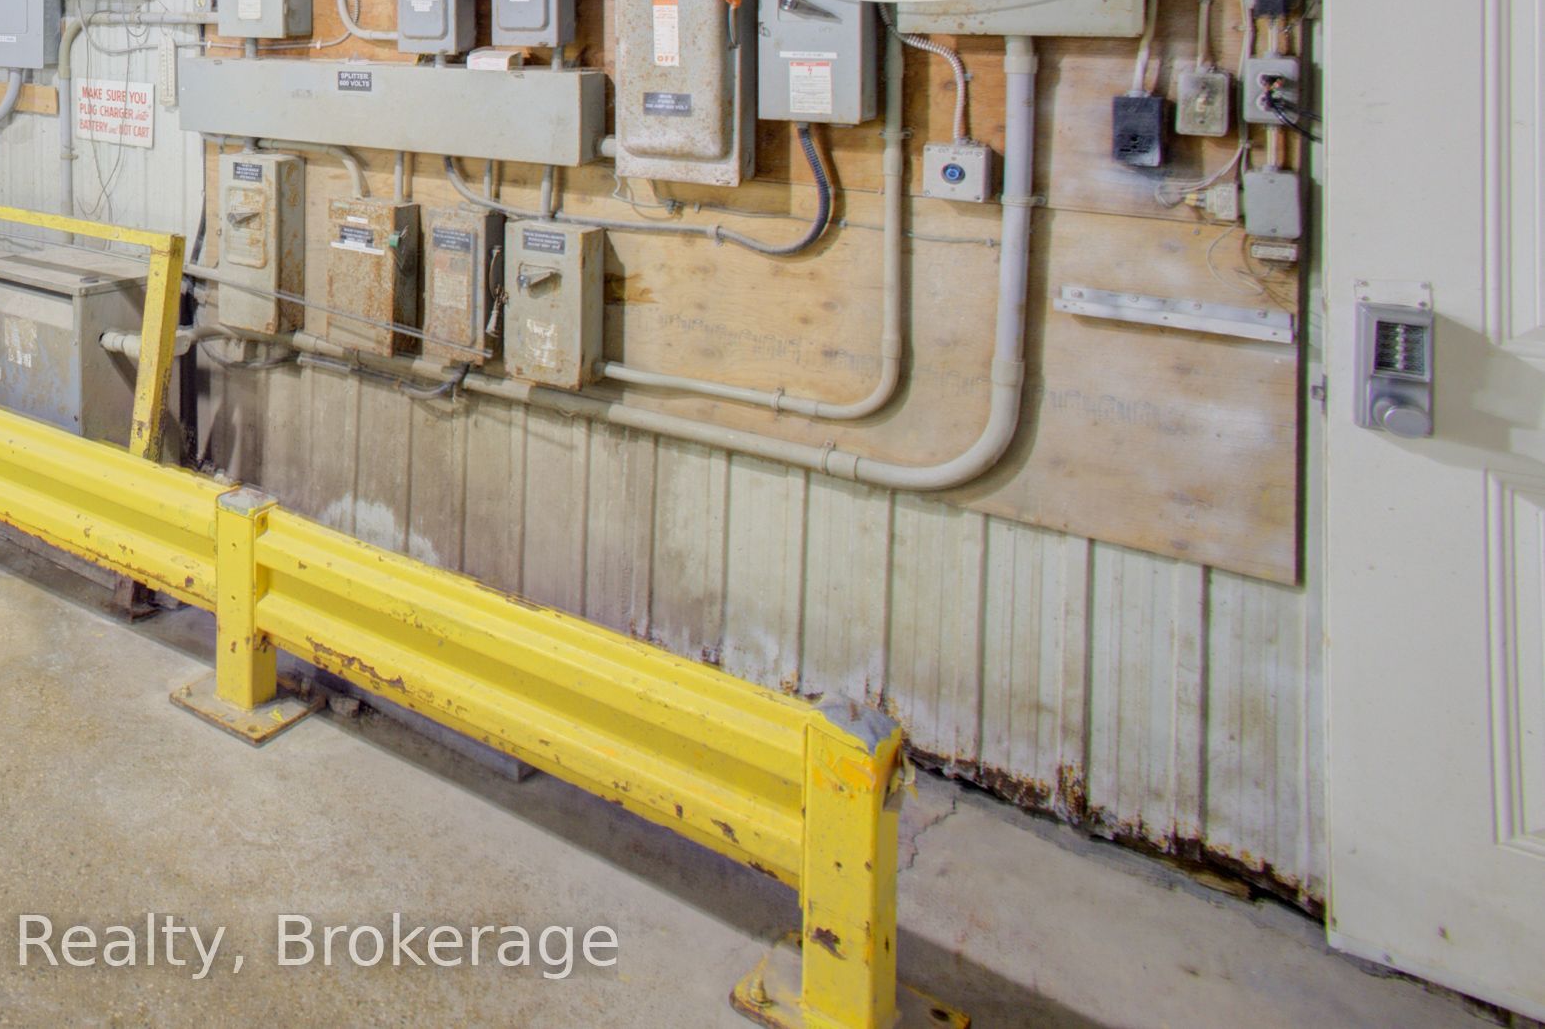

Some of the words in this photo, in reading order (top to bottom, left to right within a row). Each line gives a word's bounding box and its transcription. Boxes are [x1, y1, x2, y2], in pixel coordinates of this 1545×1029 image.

[82, 86, 103, 100] MAKE
[106, 89, 126, 102] SURE
[129, 91, 147, 104] YOU
[79, 103, 98, 115] PLUG
[100, 105, 134, 120] CHARGER
[79, 119, 108, 133] BATTERY
[134, 125, 150, 138] CART
